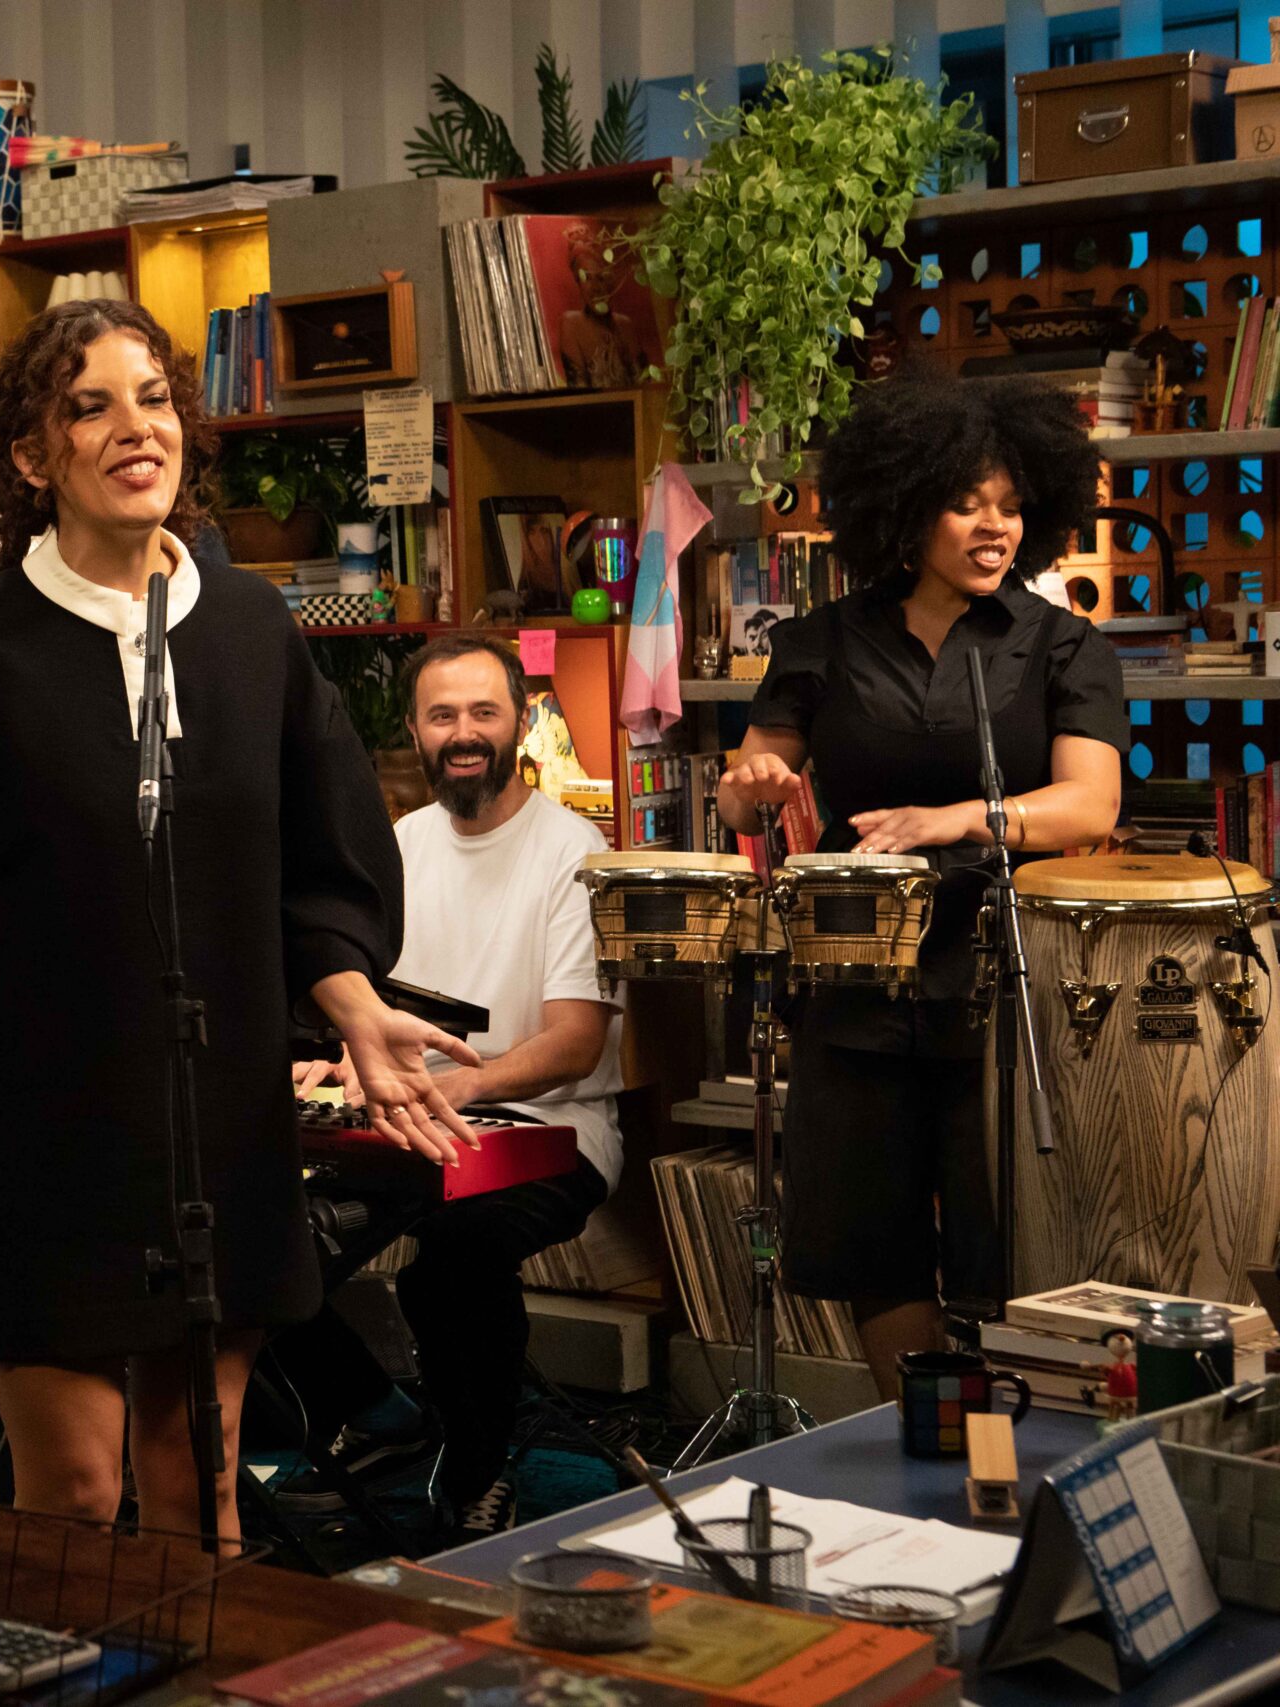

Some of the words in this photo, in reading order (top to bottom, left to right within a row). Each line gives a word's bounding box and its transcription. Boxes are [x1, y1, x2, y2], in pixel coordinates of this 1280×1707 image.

[1154, 963, 1181, 986] LP
[1148, 992, 1186, 1004] GALAXY
[1144, 1019, 1193, 1030] GIOVANNI
